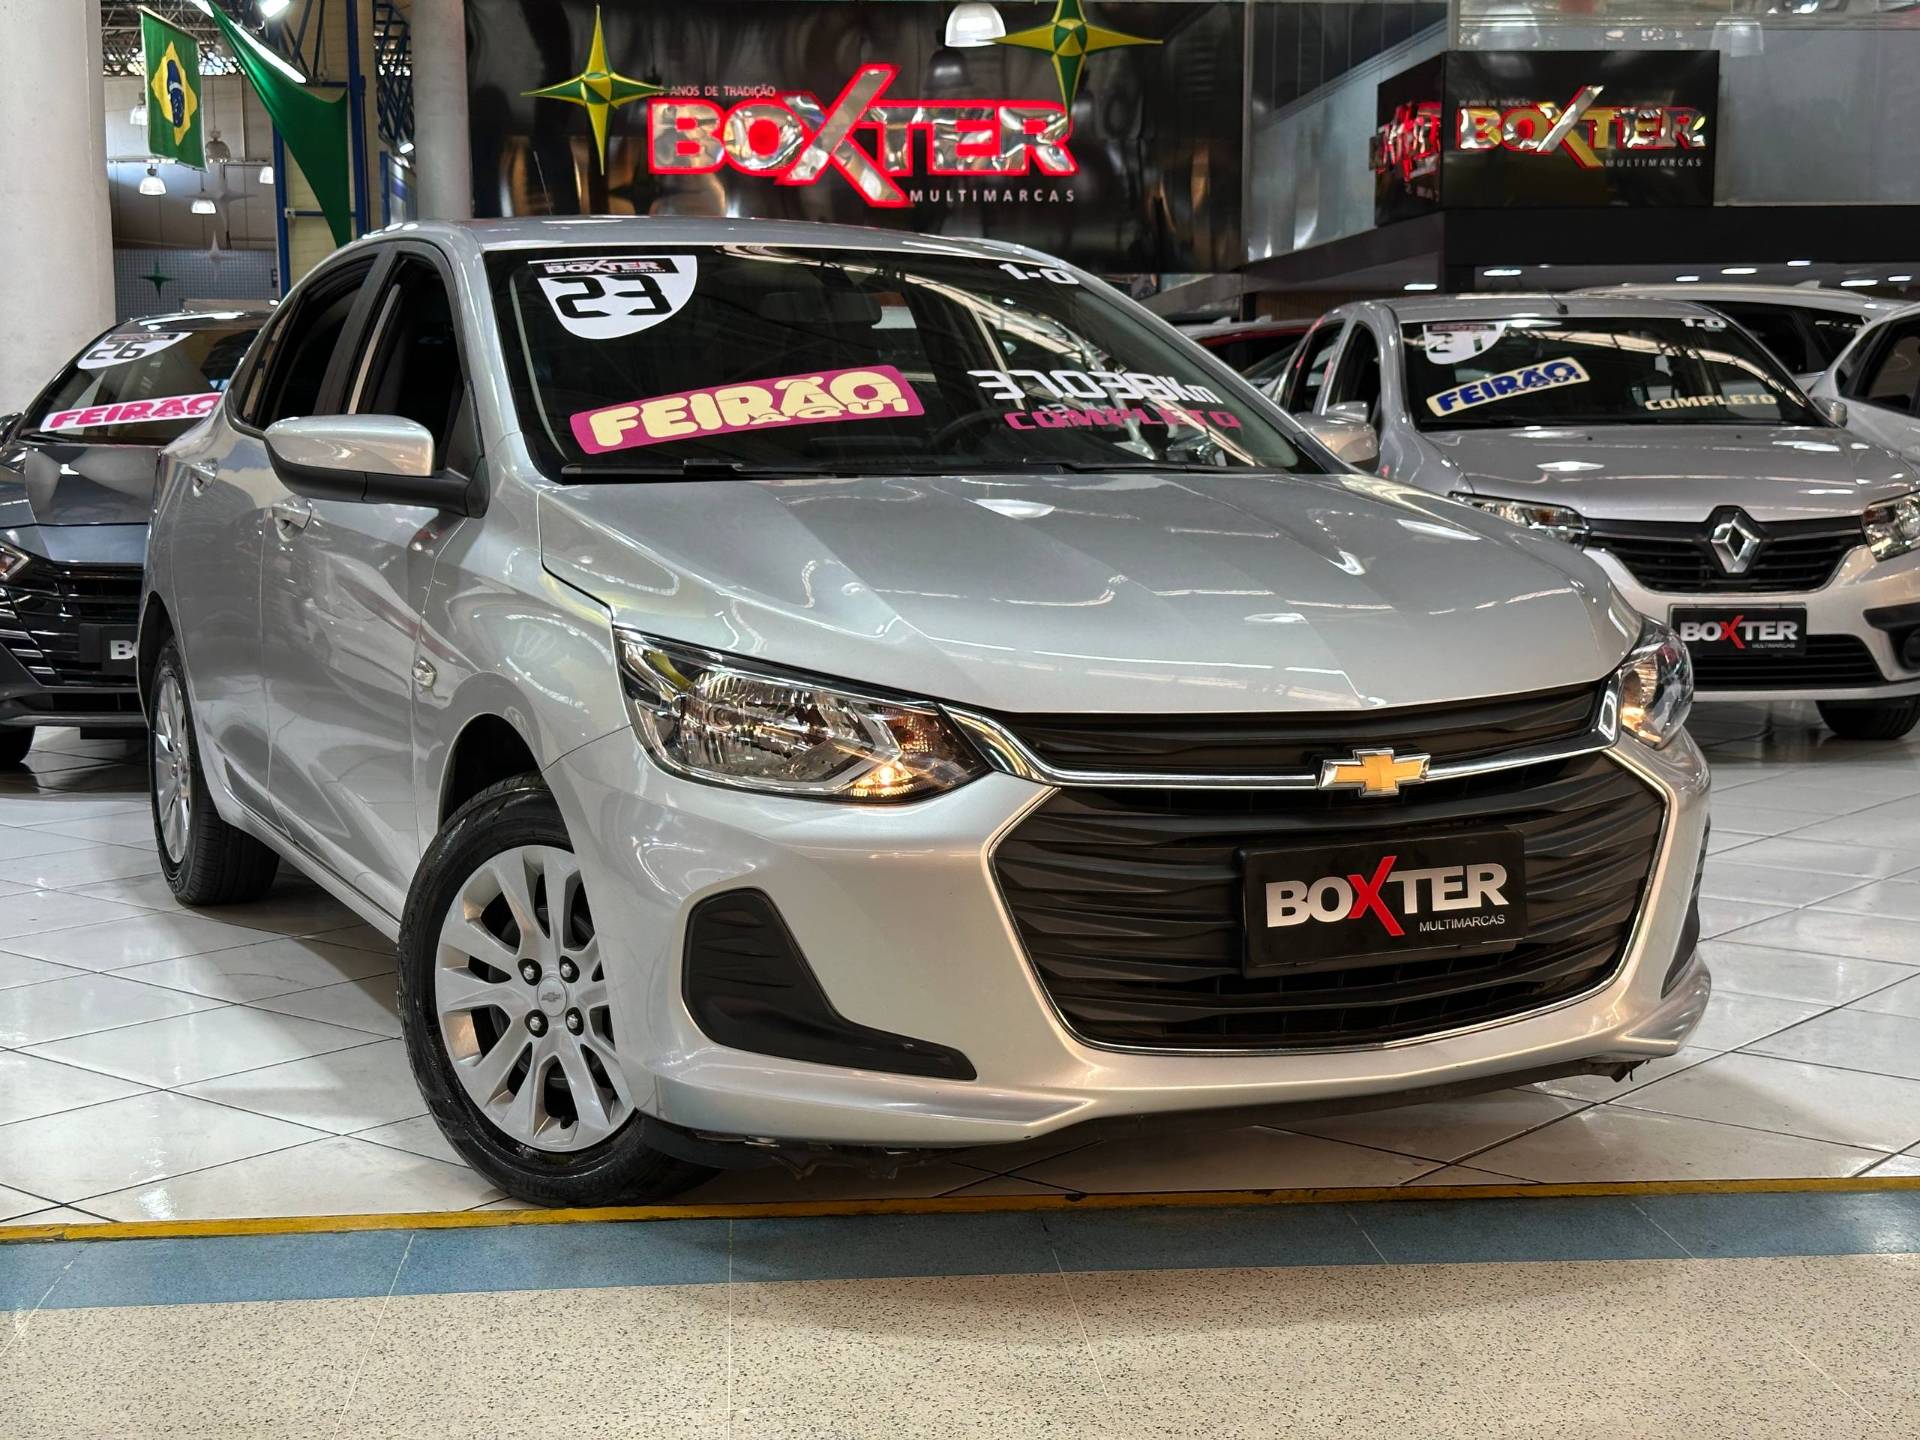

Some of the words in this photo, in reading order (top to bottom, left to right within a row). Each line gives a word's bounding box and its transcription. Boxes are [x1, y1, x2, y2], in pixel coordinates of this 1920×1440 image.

[671, 86, 699, 96] ANOS
[705, 86, 719, 96] DE
[724, 84, 776, 98] TRADIÇÃO
[648, 64, 1078, 207] BOXTER
[1456, 85, 1706, 169] BOXTER
[1604, 159, 1702, 168] MULTIMARCAS
[909, 189, 1075, 203] MULTIMARCAS
[545, 259, 662, 274] BOXTER
[550, 274, 673, 319] 23
[86, 341, 146, 360] 26
[1437, 362, 1577, 411] FEIRÃO
[588, 371, 903, 447] FEIRÃO
[1645, 394, 1777, 411] COMPLETO
[1003, 407, 1242, 430] COMPLETO
[1680, 615, 1798, 648] BOXTER
[111, 640, 138, 660] B
[1265, 855, 1509, 936] BOXTER
[1419, 914, 1505, 933] MULTIMARCAS
